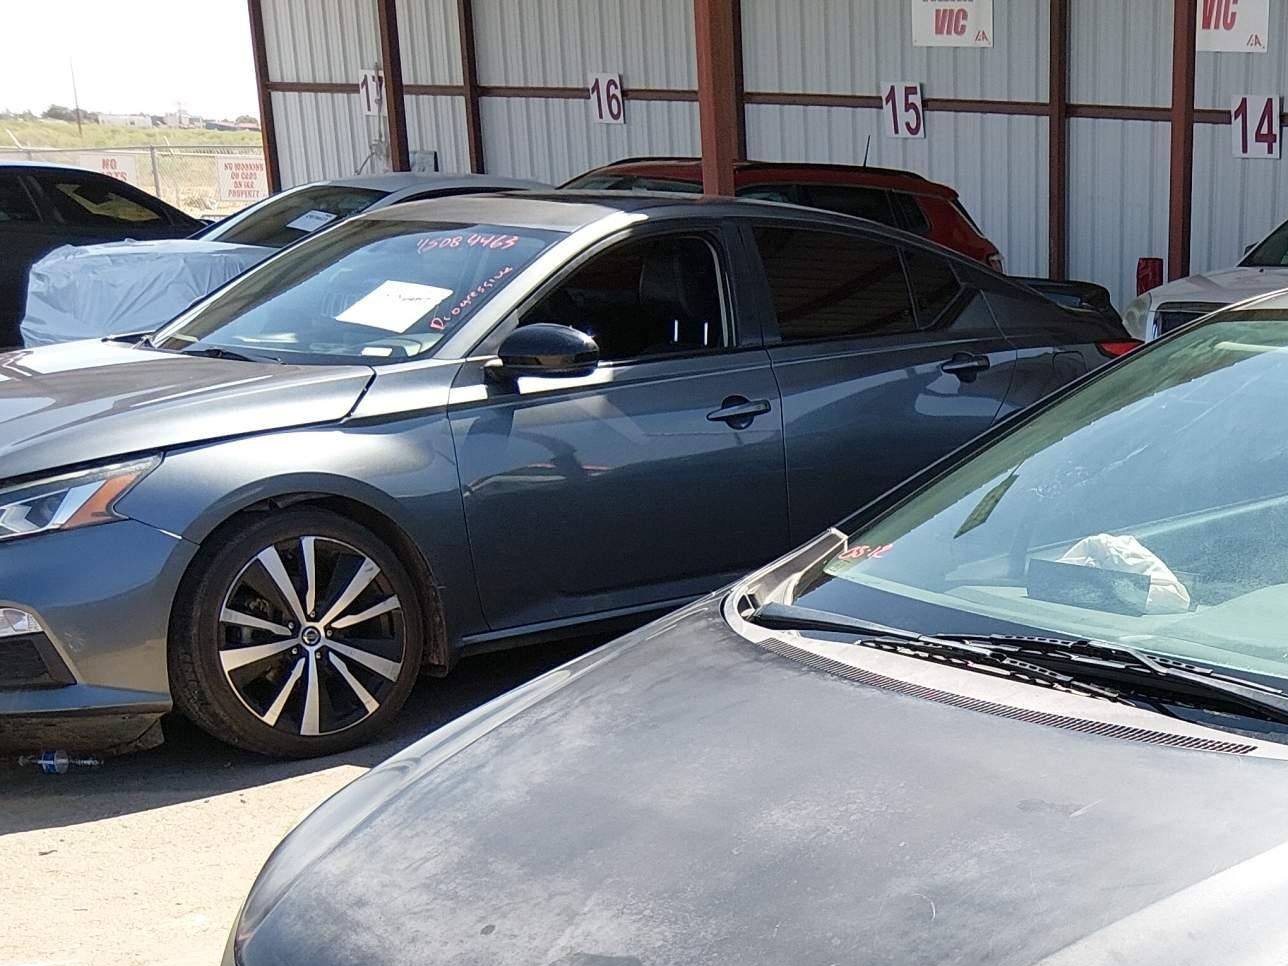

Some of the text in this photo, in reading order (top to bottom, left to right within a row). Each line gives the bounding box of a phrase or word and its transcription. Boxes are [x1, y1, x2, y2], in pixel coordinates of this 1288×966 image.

[934, 8, 968, 36] VIC
[590, 77, 622, 121] 16
[885, 84, 922, 136] 15
[1233, 96, 1277, 155] 14
